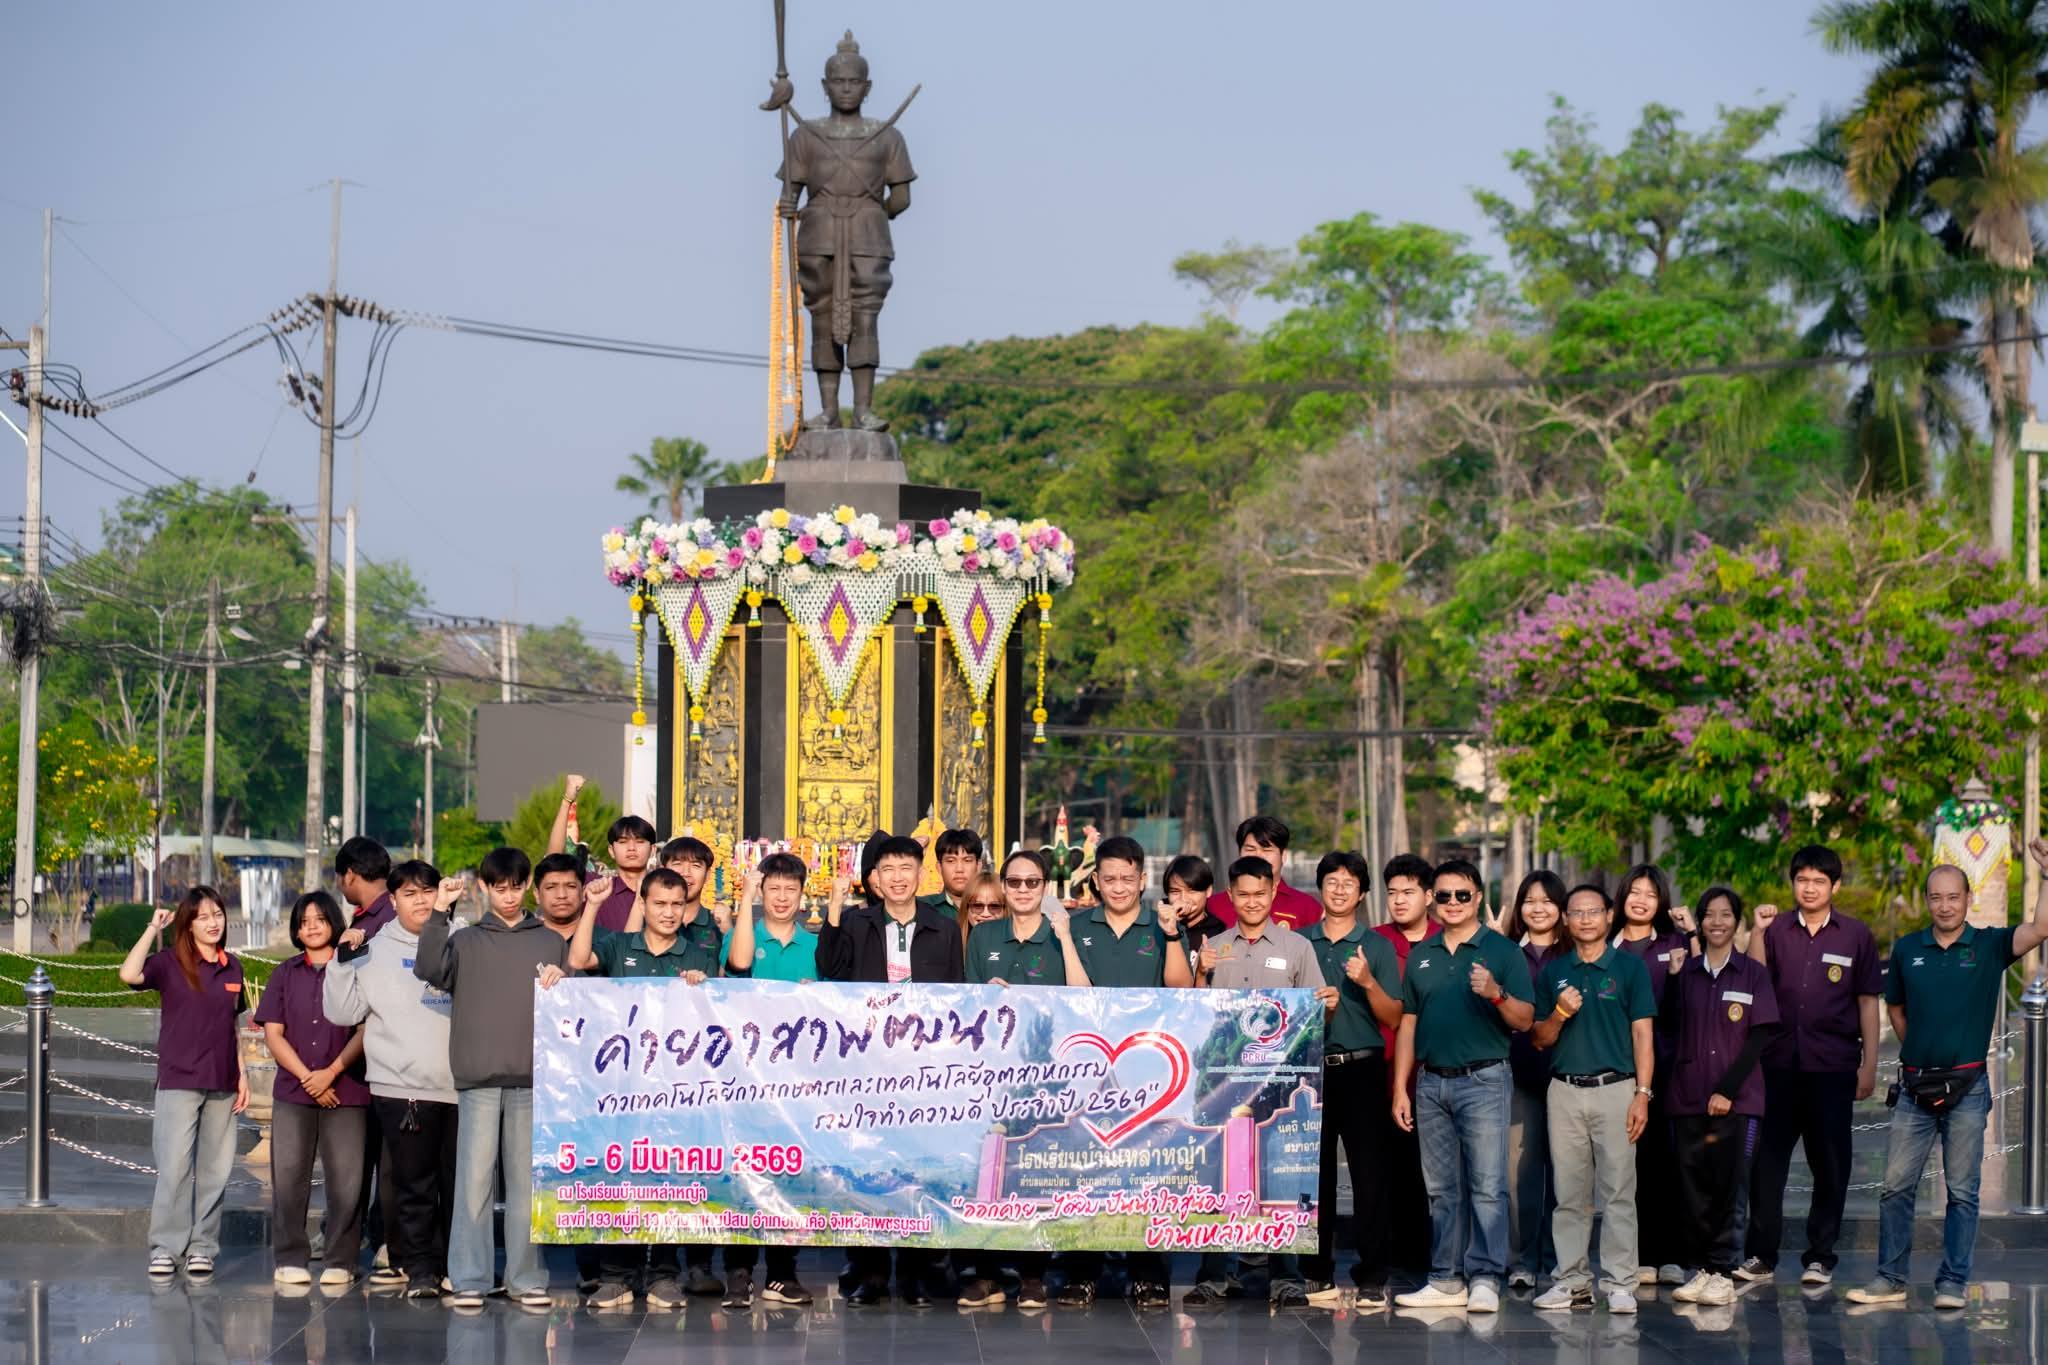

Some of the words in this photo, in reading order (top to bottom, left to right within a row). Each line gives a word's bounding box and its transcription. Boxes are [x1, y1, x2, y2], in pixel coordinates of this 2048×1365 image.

[815, 1096, 984, 1129] รวมใจทำความดี
[992, 1089, 1076, 1118] ประจำปี
[559, 1143, 577, 1172] 5
[606, 1144, 623, 1172] 6
[631, 1138, 722, 1172] มีนาคม
[732, 1145, 803, 1173] 2569
[559, 1186, 574, 1200] ณ
[576, 1182, 706, 1204] โรงเรียนบ้านเหล่าหญ้า
[557, 1206, 585, 1227] เลขที่
[589, 1213, 611, 1227] 193
[613, 1207, 640, 1232] หมู่ที่
